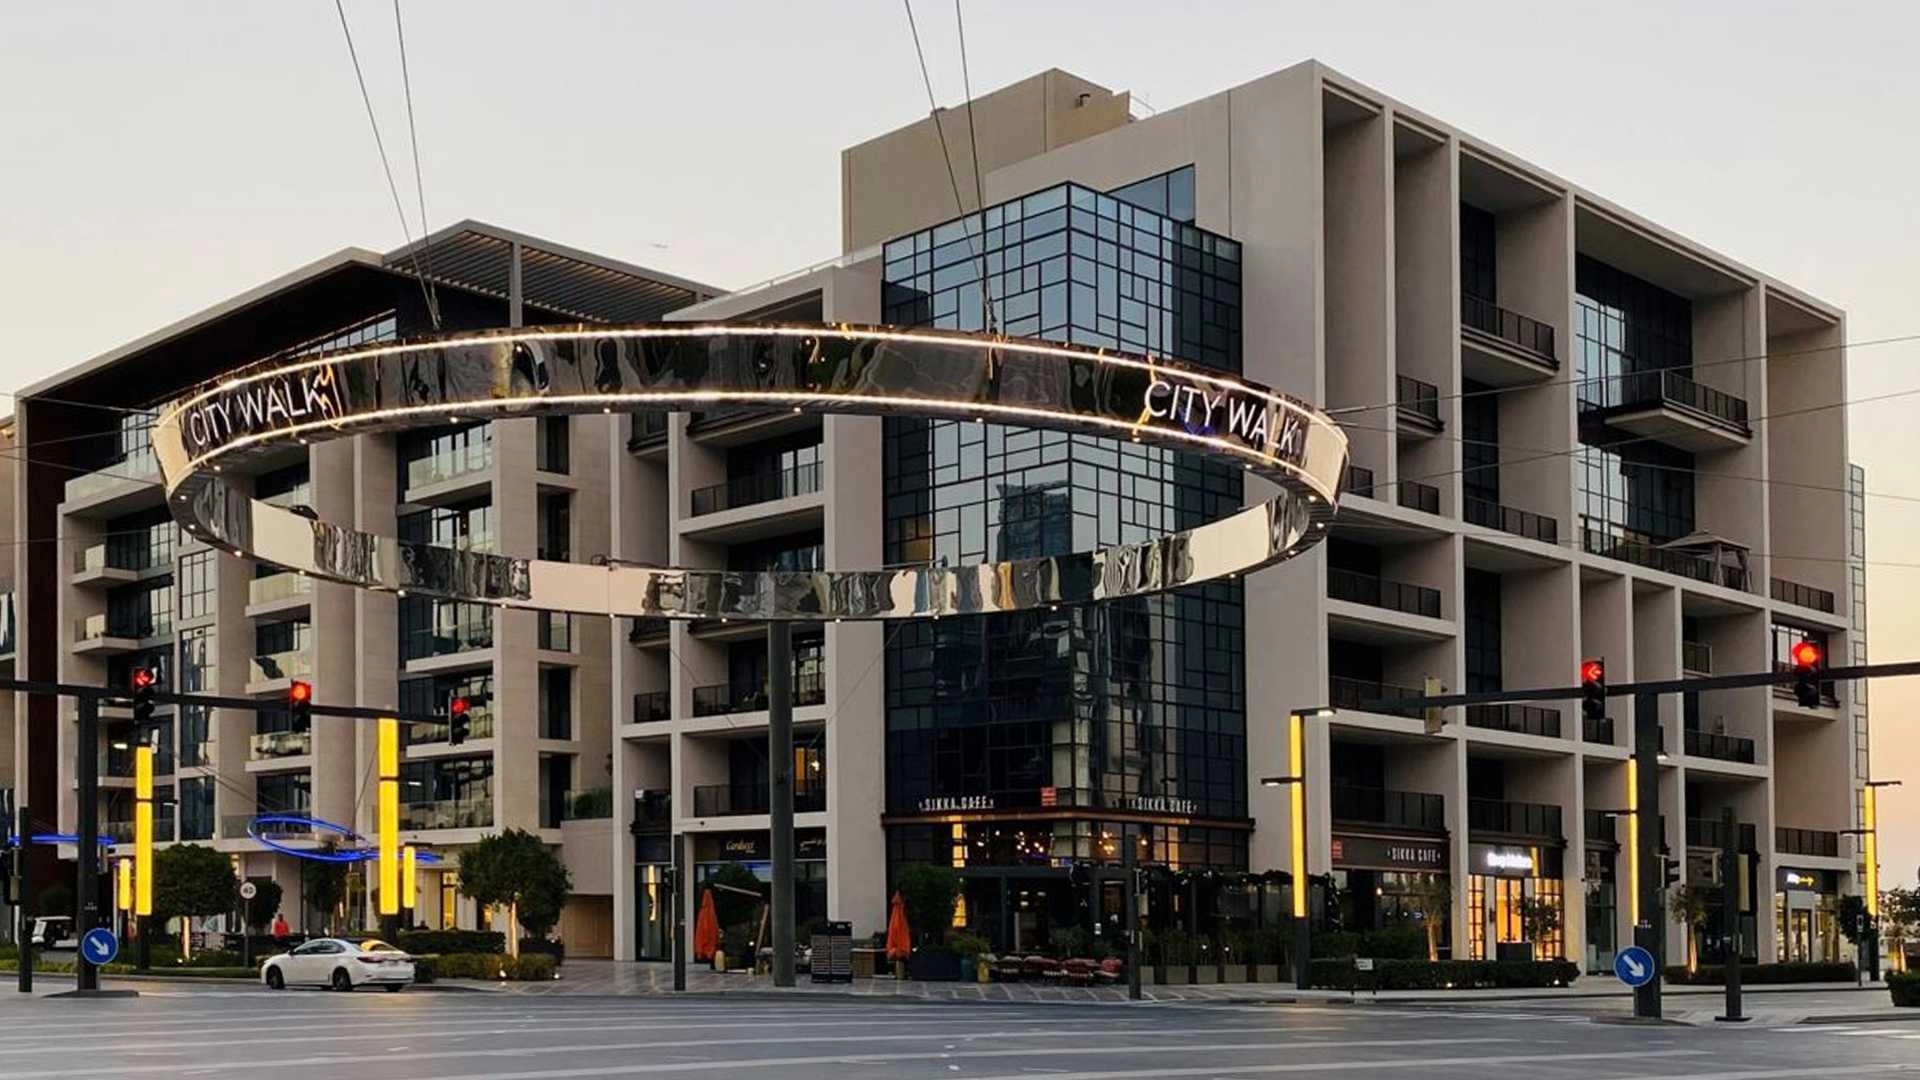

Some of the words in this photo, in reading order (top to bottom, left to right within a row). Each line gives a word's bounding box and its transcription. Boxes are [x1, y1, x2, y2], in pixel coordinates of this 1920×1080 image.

[190, 397, 232, 446] CITY
[237, 374, 328, 427] WALK
[1144, 380, 1222, 428] CITY
[1228, 397, 1299, 454] WALK
[925, 797, 956, 812] SIKKA
[960, 795, 987, 810] CAFE
[1137, 796, 1167, 812] SIKKA
[1391, 846, 1415, 861] SIKKA
[1417, 848, 1437, 863] CAFE
